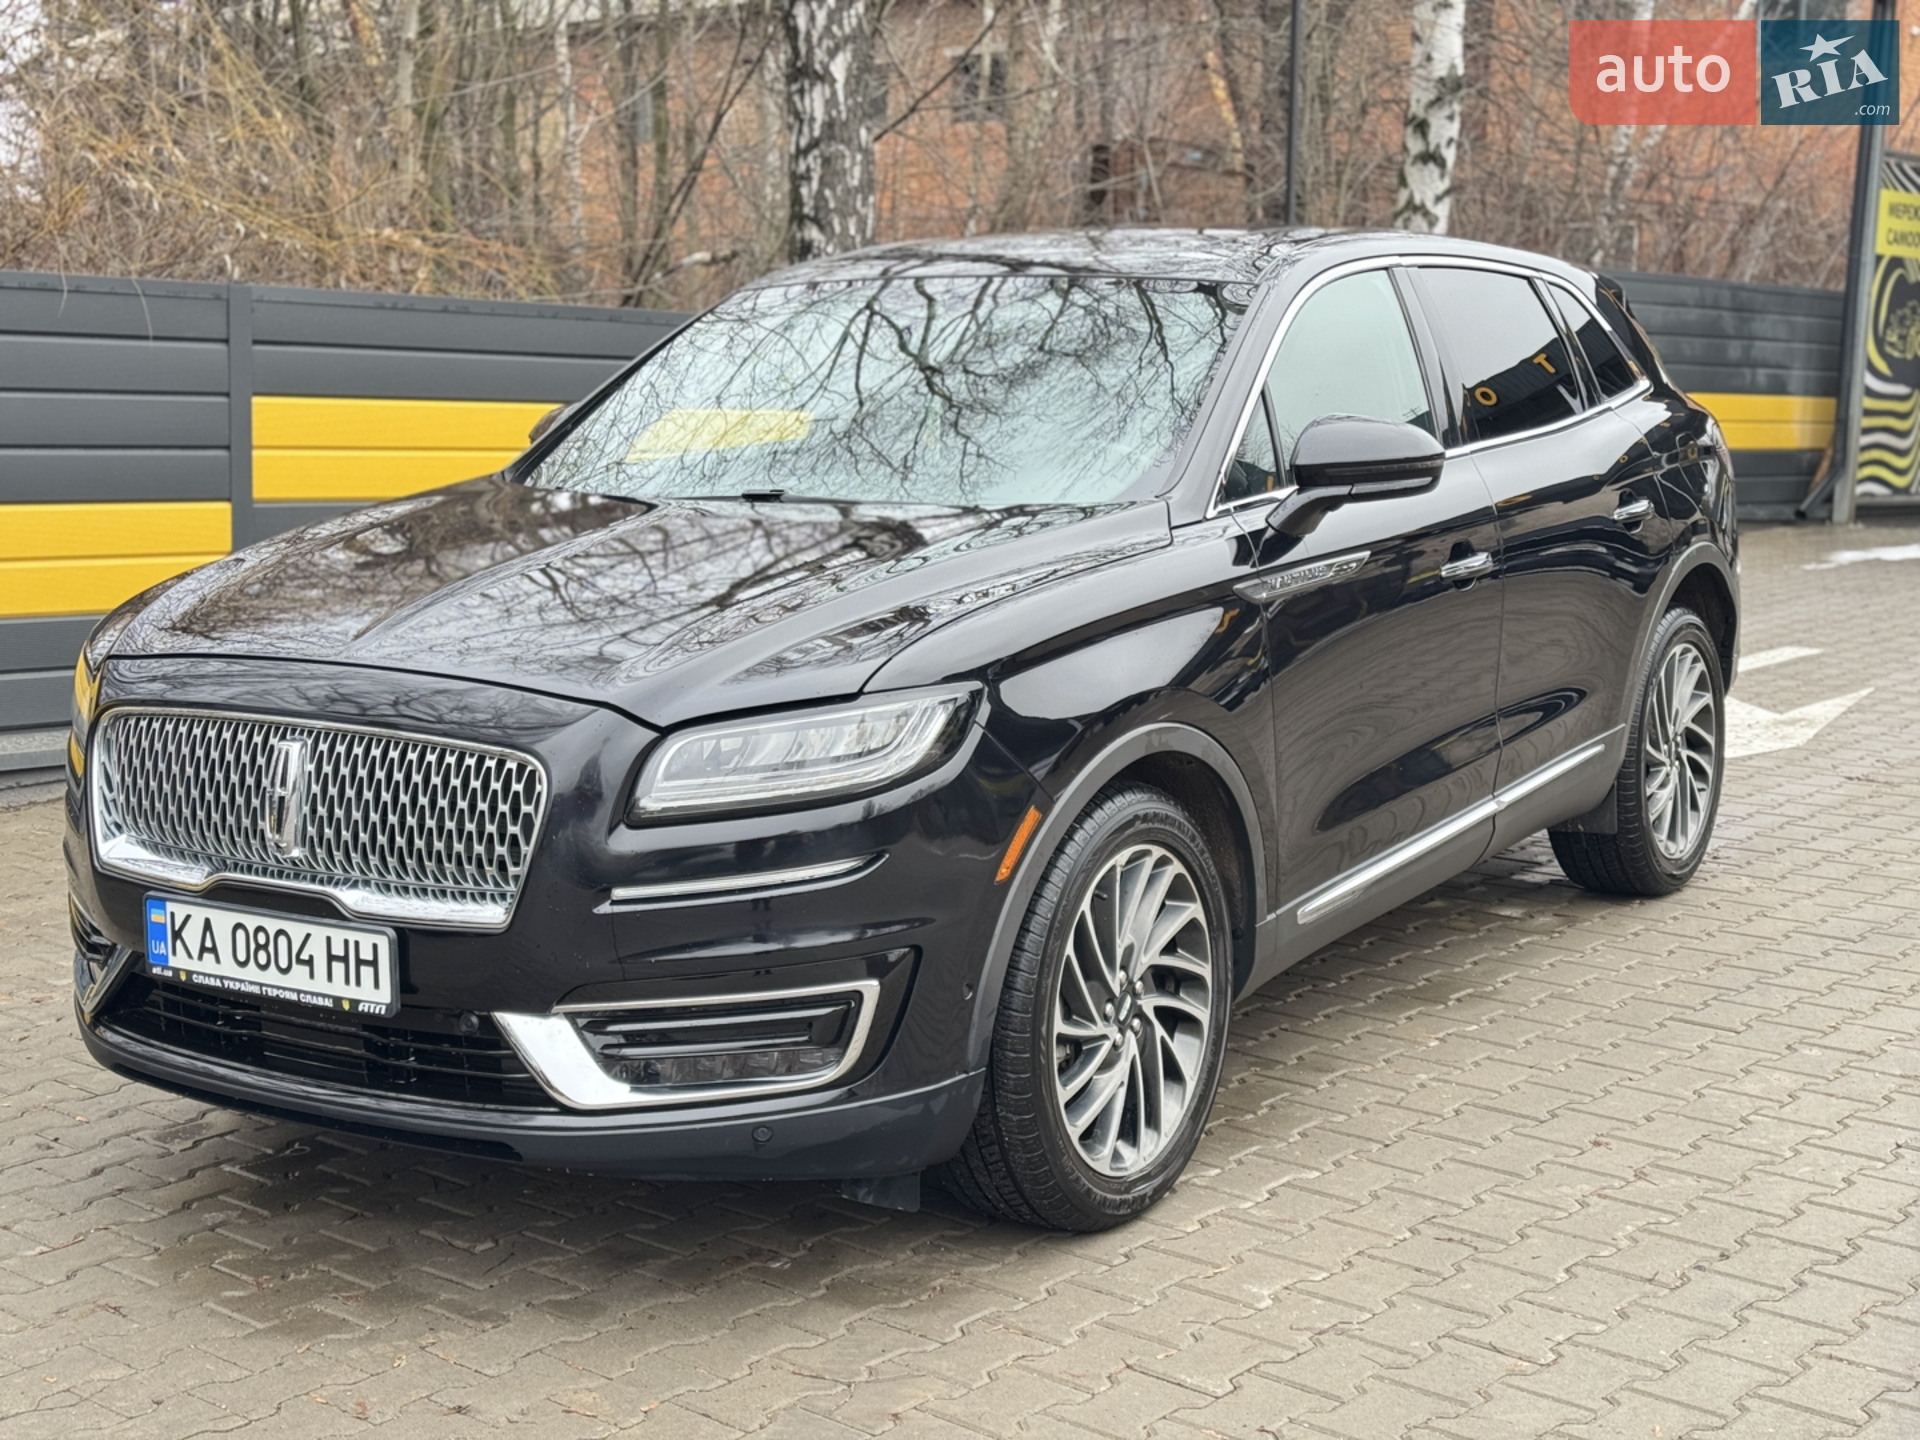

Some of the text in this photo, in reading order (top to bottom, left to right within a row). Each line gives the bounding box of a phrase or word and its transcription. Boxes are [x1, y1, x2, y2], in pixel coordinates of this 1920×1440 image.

[151, 938, 168, 956] UA
[170, 911, 380, 990] KA 0804 HH
[192, 973, 222, 988] СЛАВА
[262, 985, 298, 1002] ГЕРОЯМ
